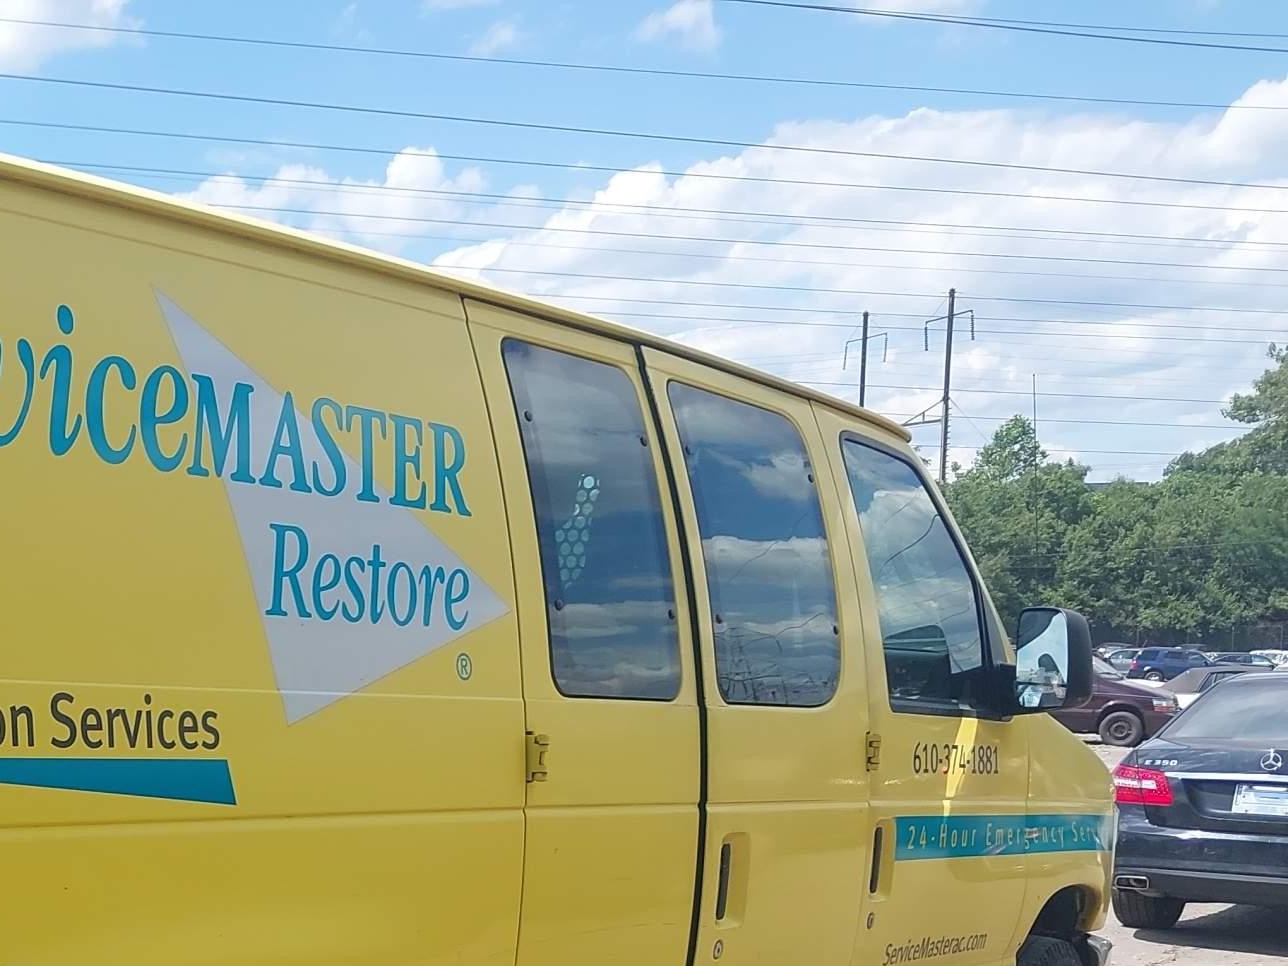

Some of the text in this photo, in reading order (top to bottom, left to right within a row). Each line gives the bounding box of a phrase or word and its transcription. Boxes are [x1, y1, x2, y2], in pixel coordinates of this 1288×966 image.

[265, 523, 470, 631] Restore
[50, 692, 222, 750] Services
[913, 741, 999, 775] 610-374-1881
[907, 824, 977, 849] 24-Hour
[882, 932, 988, 966] ServiceMasterac.com
